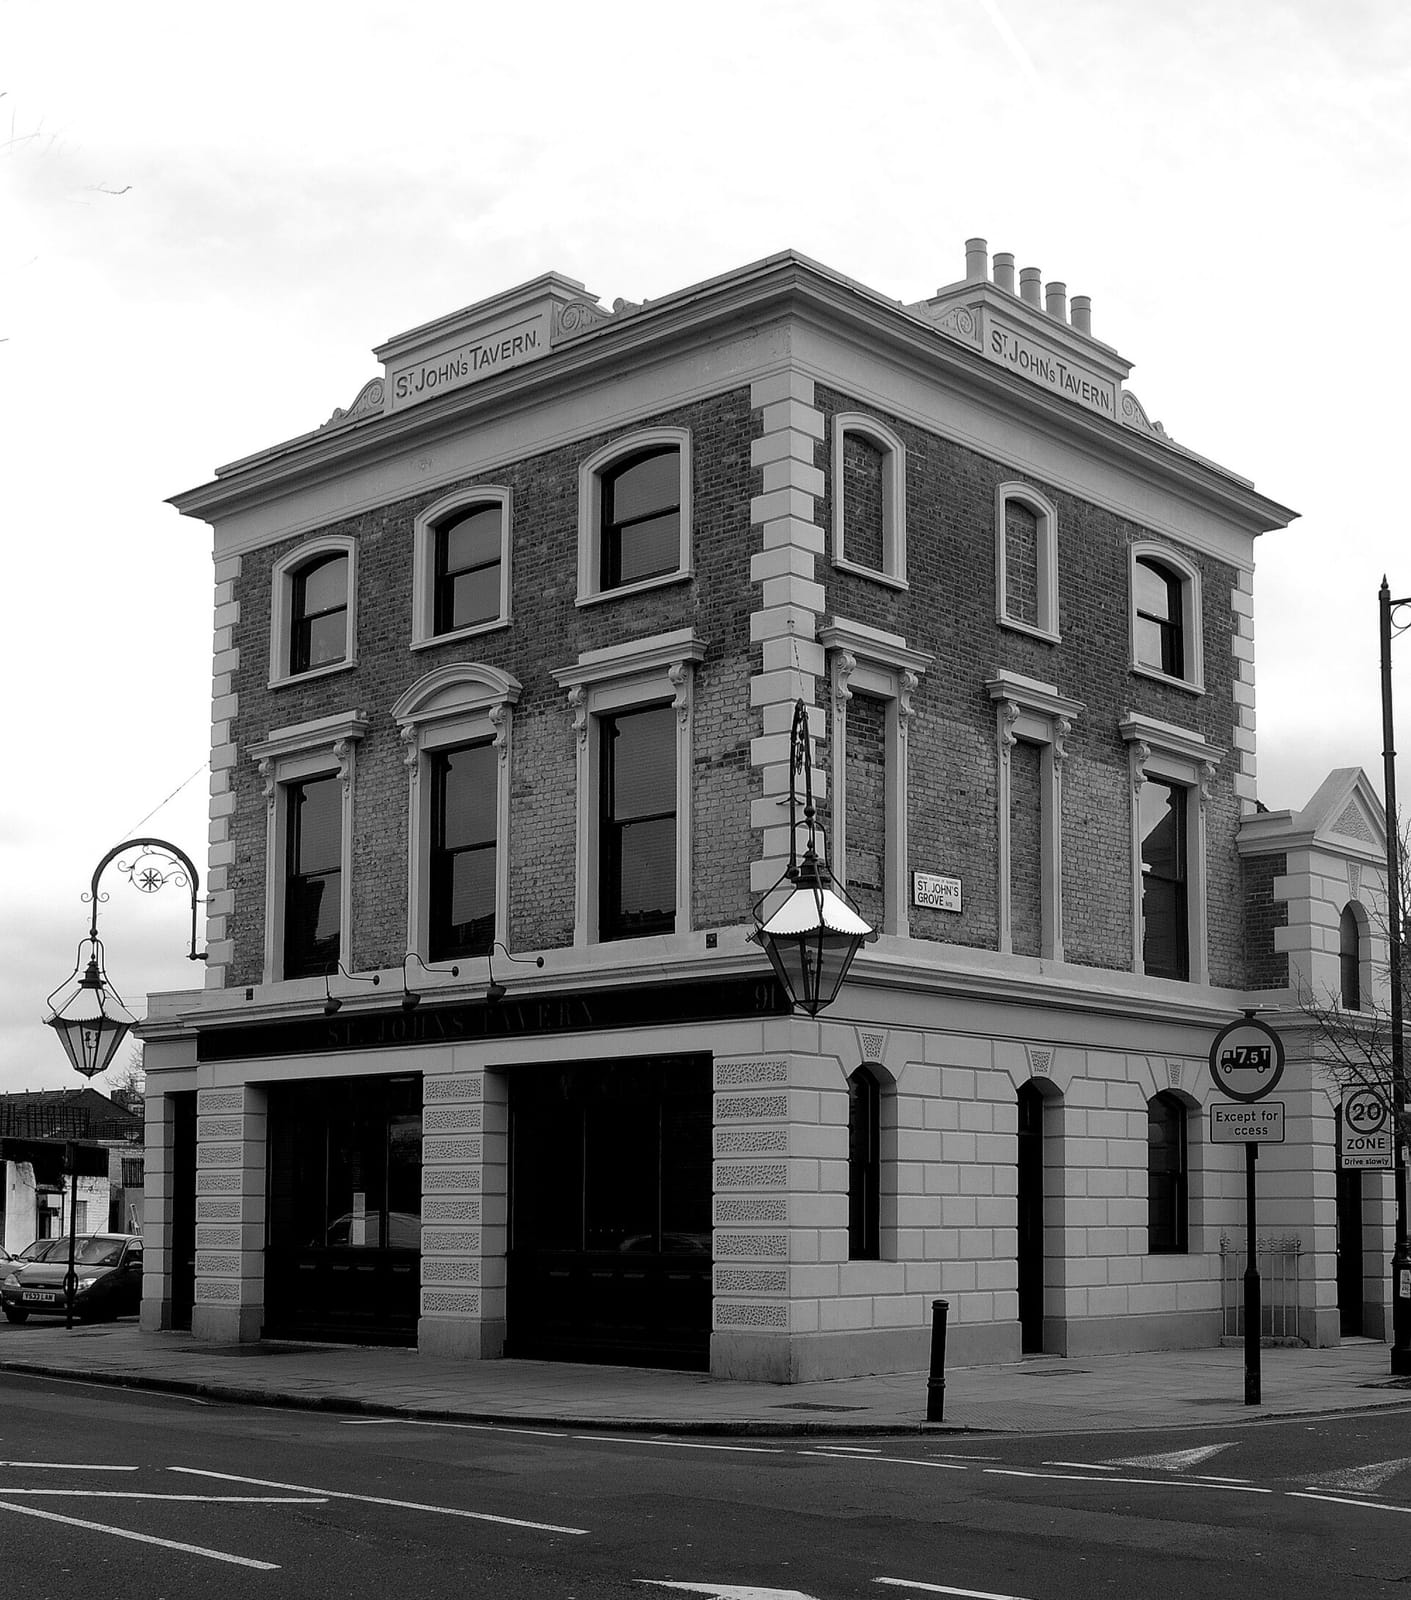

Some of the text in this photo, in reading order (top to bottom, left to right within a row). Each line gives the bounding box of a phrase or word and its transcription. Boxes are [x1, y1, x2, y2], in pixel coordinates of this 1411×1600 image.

[931, 883, 959, 897] JOHN'S
[917, 892, 944, 906] GROVE
[1215, 1109, 1279, 1124] Except for
[1352, 1102, 1382, 1122] 20
[1346, 1137, 1386, 1150] ZONE
[1344, 1157, 1389, 1166] Drive slowly
